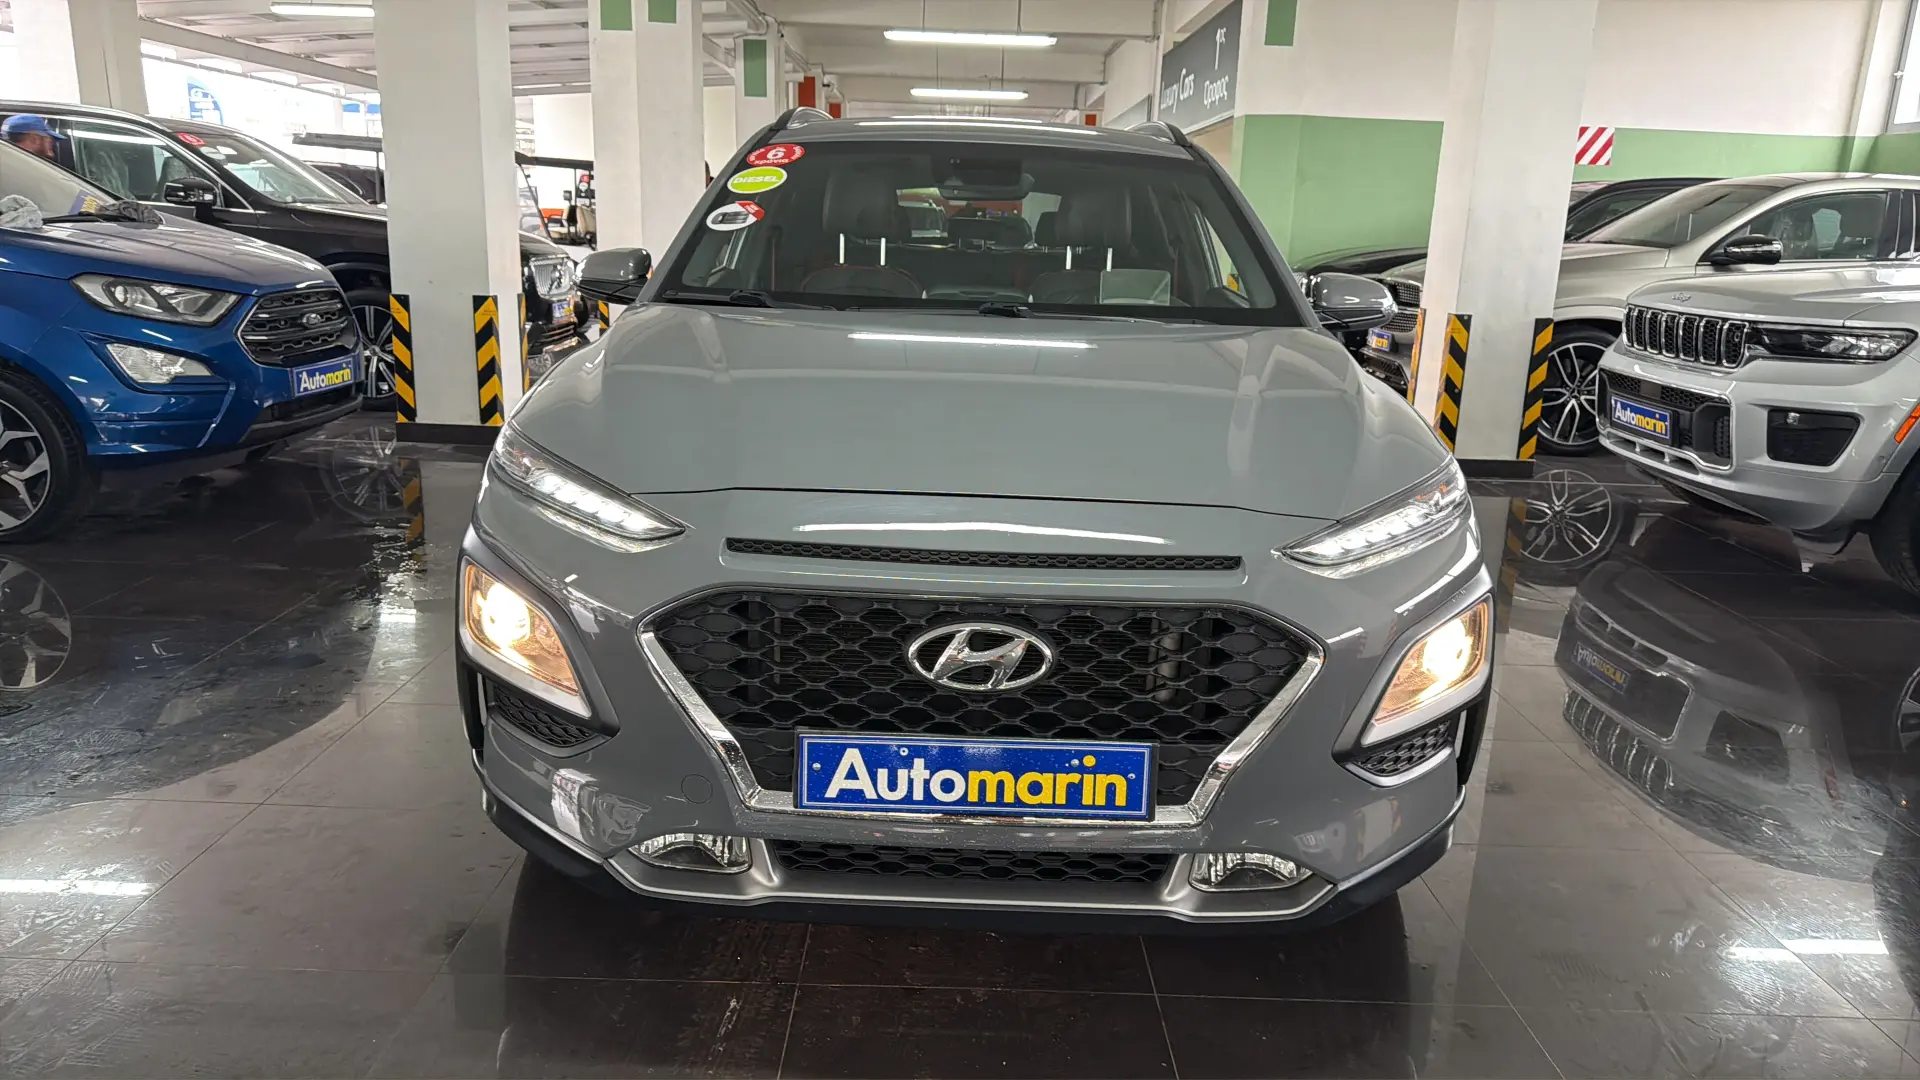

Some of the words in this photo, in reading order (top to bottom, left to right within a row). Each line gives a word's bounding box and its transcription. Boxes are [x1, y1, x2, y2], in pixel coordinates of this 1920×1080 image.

[1160, 81, 1180, 113] Luxury
[1180, 68, 1195, 100] Cars
[766, 147, 787, 160] 6
[733, 175, 779, 184] DIESEL
[300, 363, 352, 392] Automarin
[1614, 401, 1667, 435] Automarin
[824, 747, 1128, 807] Automarin
